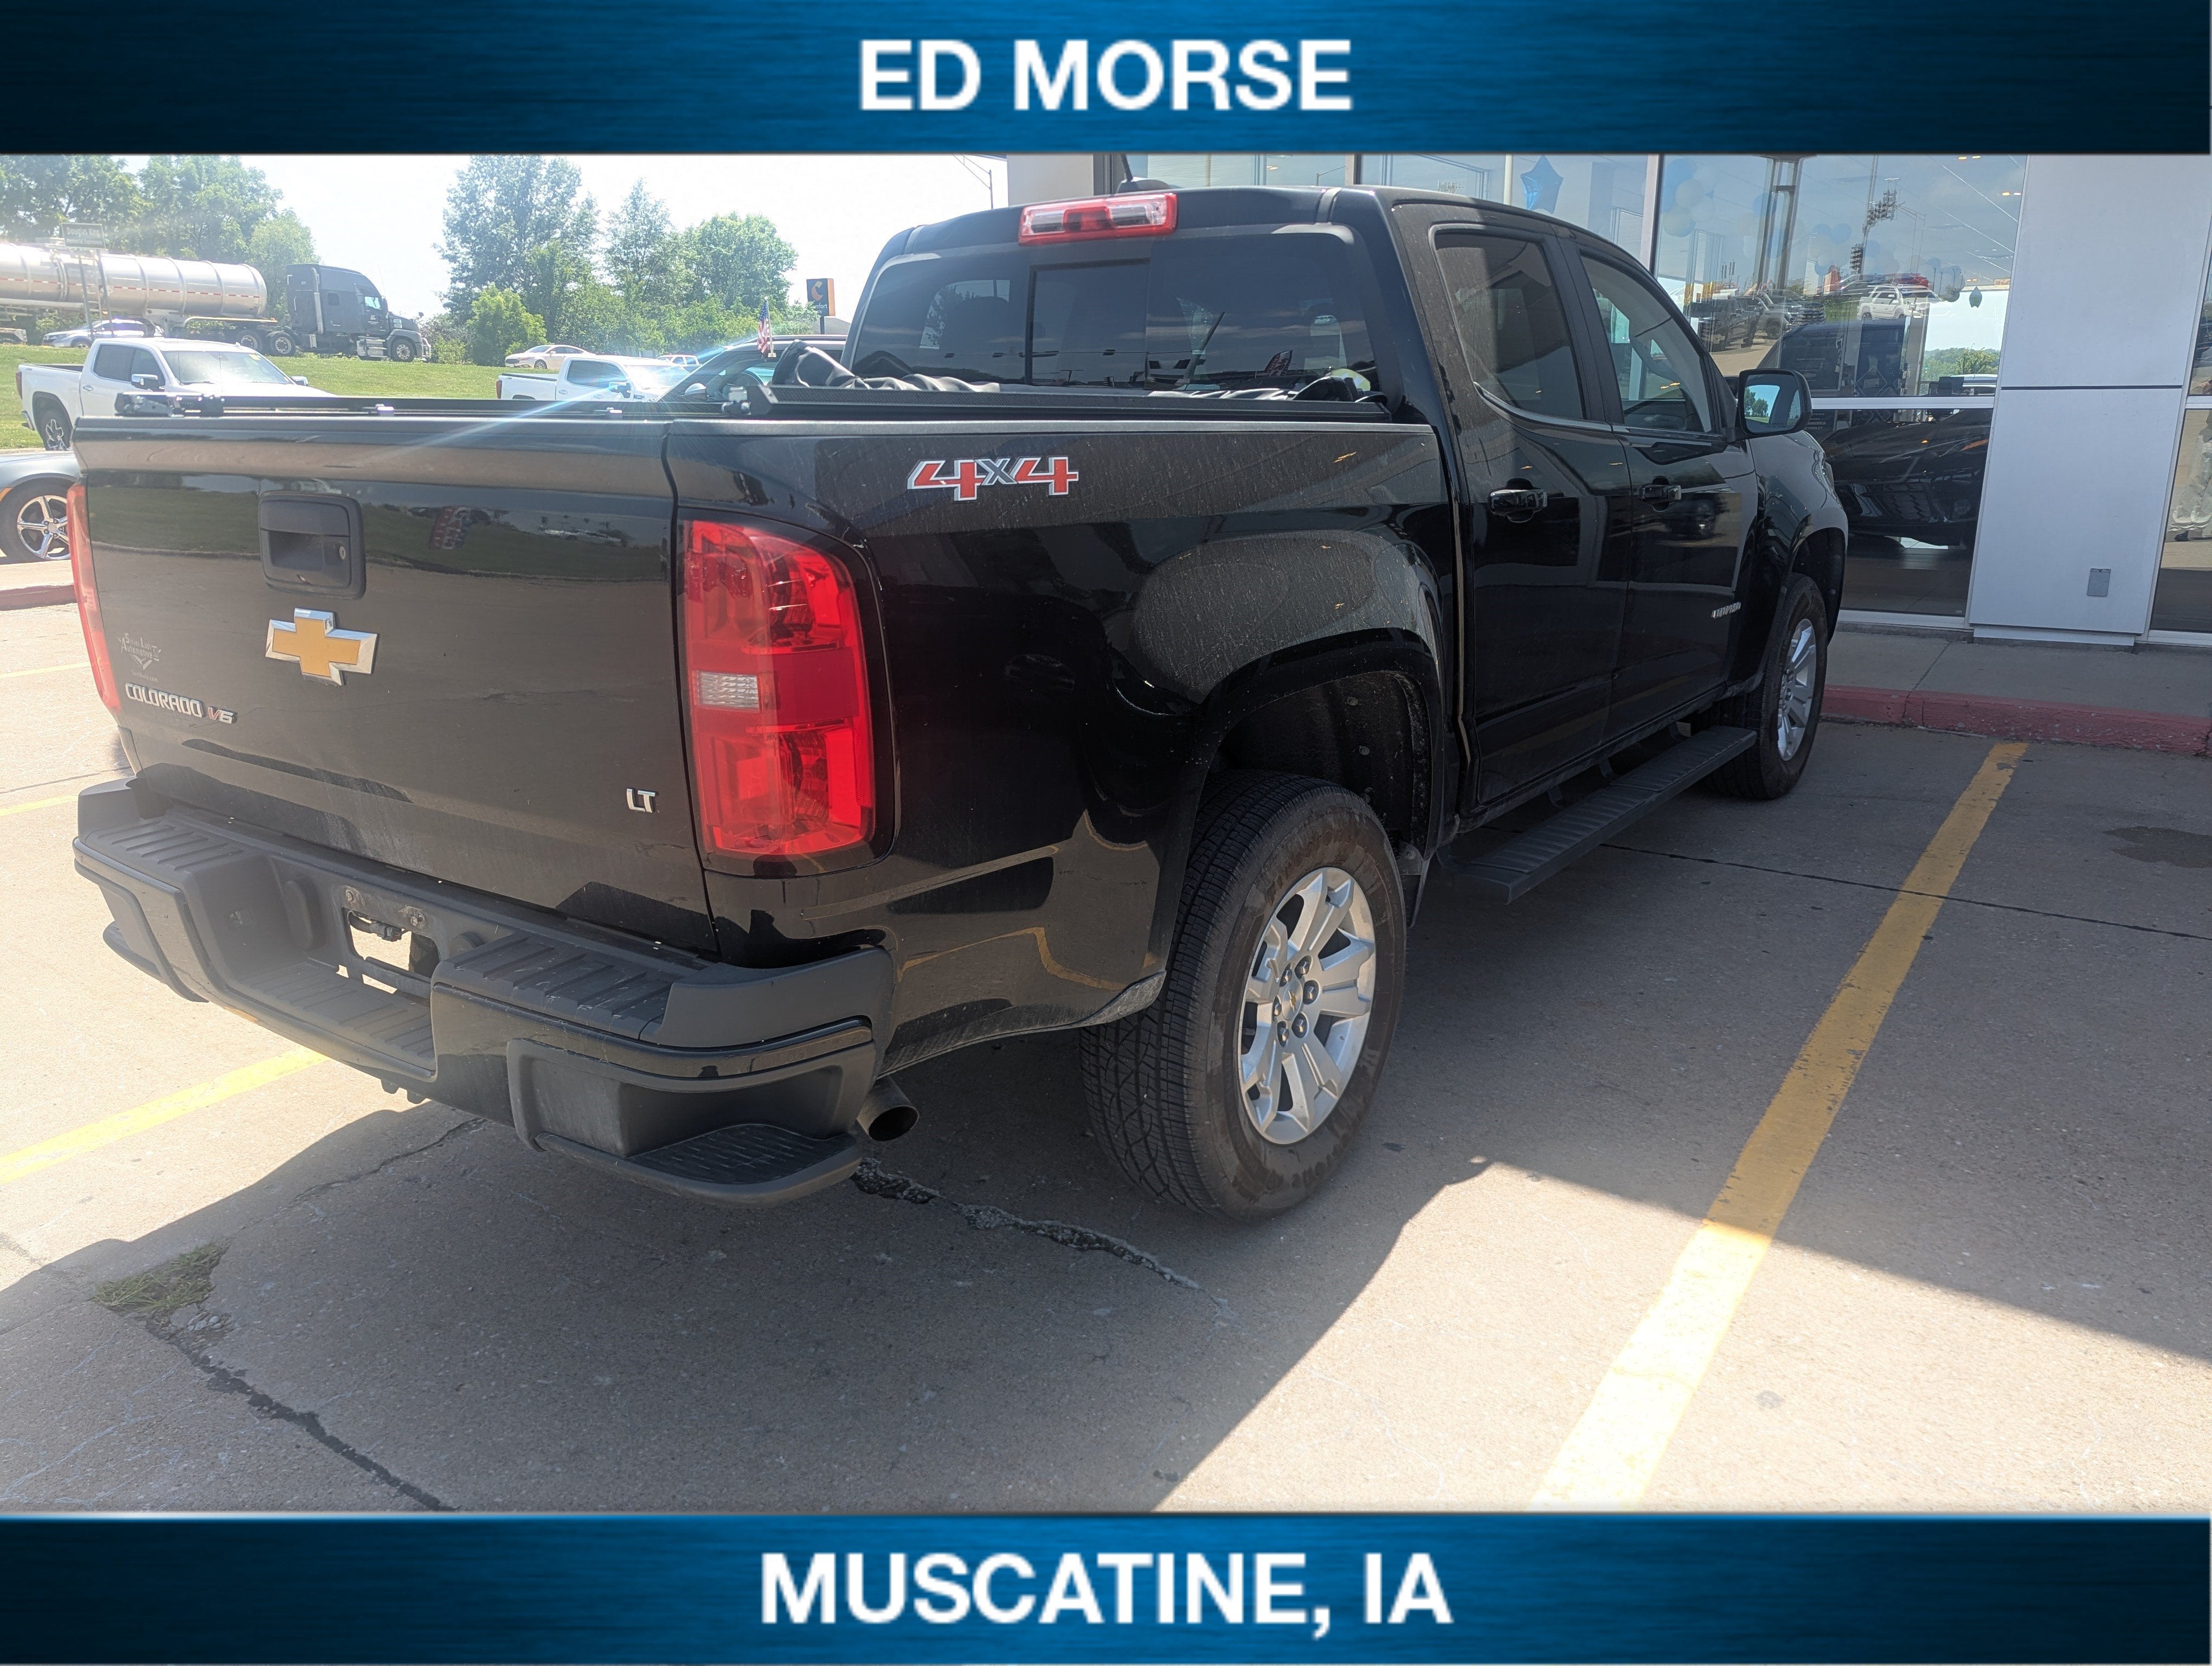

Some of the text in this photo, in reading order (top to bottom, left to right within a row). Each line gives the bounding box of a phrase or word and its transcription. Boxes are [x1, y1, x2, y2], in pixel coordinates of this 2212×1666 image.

[125, 682, 236, 725] COLORADO V6
[626, 787, 657, 813] LT
